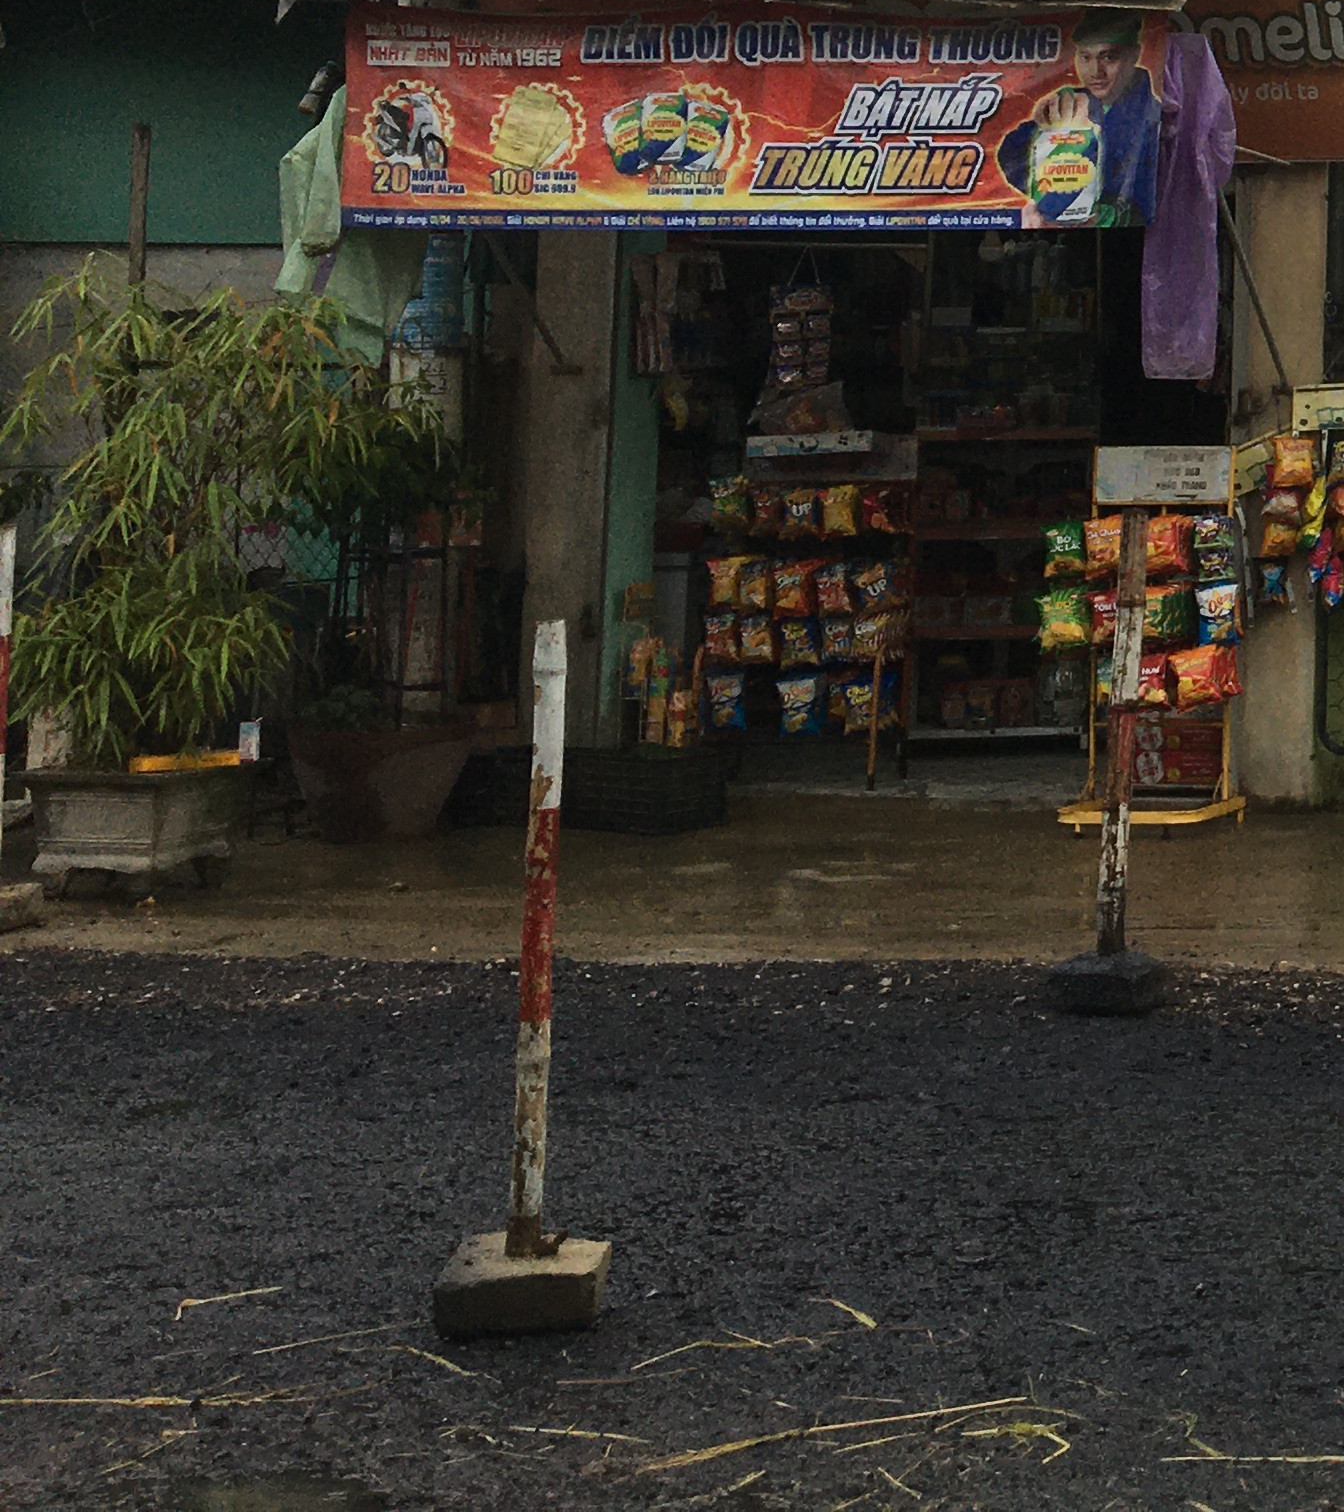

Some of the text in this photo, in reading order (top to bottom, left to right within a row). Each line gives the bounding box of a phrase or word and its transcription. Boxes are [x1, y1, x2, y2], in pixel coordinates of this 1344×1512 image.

[515, 48, 562, 67] 1962
[735, 16, 804, 66] QUÀ
[836, 73, 1003, 140] BẬT NẮP
[371, 162, 411, 194] 20
[490, 168, 535, 195] 100
[751, 137, 984, 194] TRÚNG VÀNG
